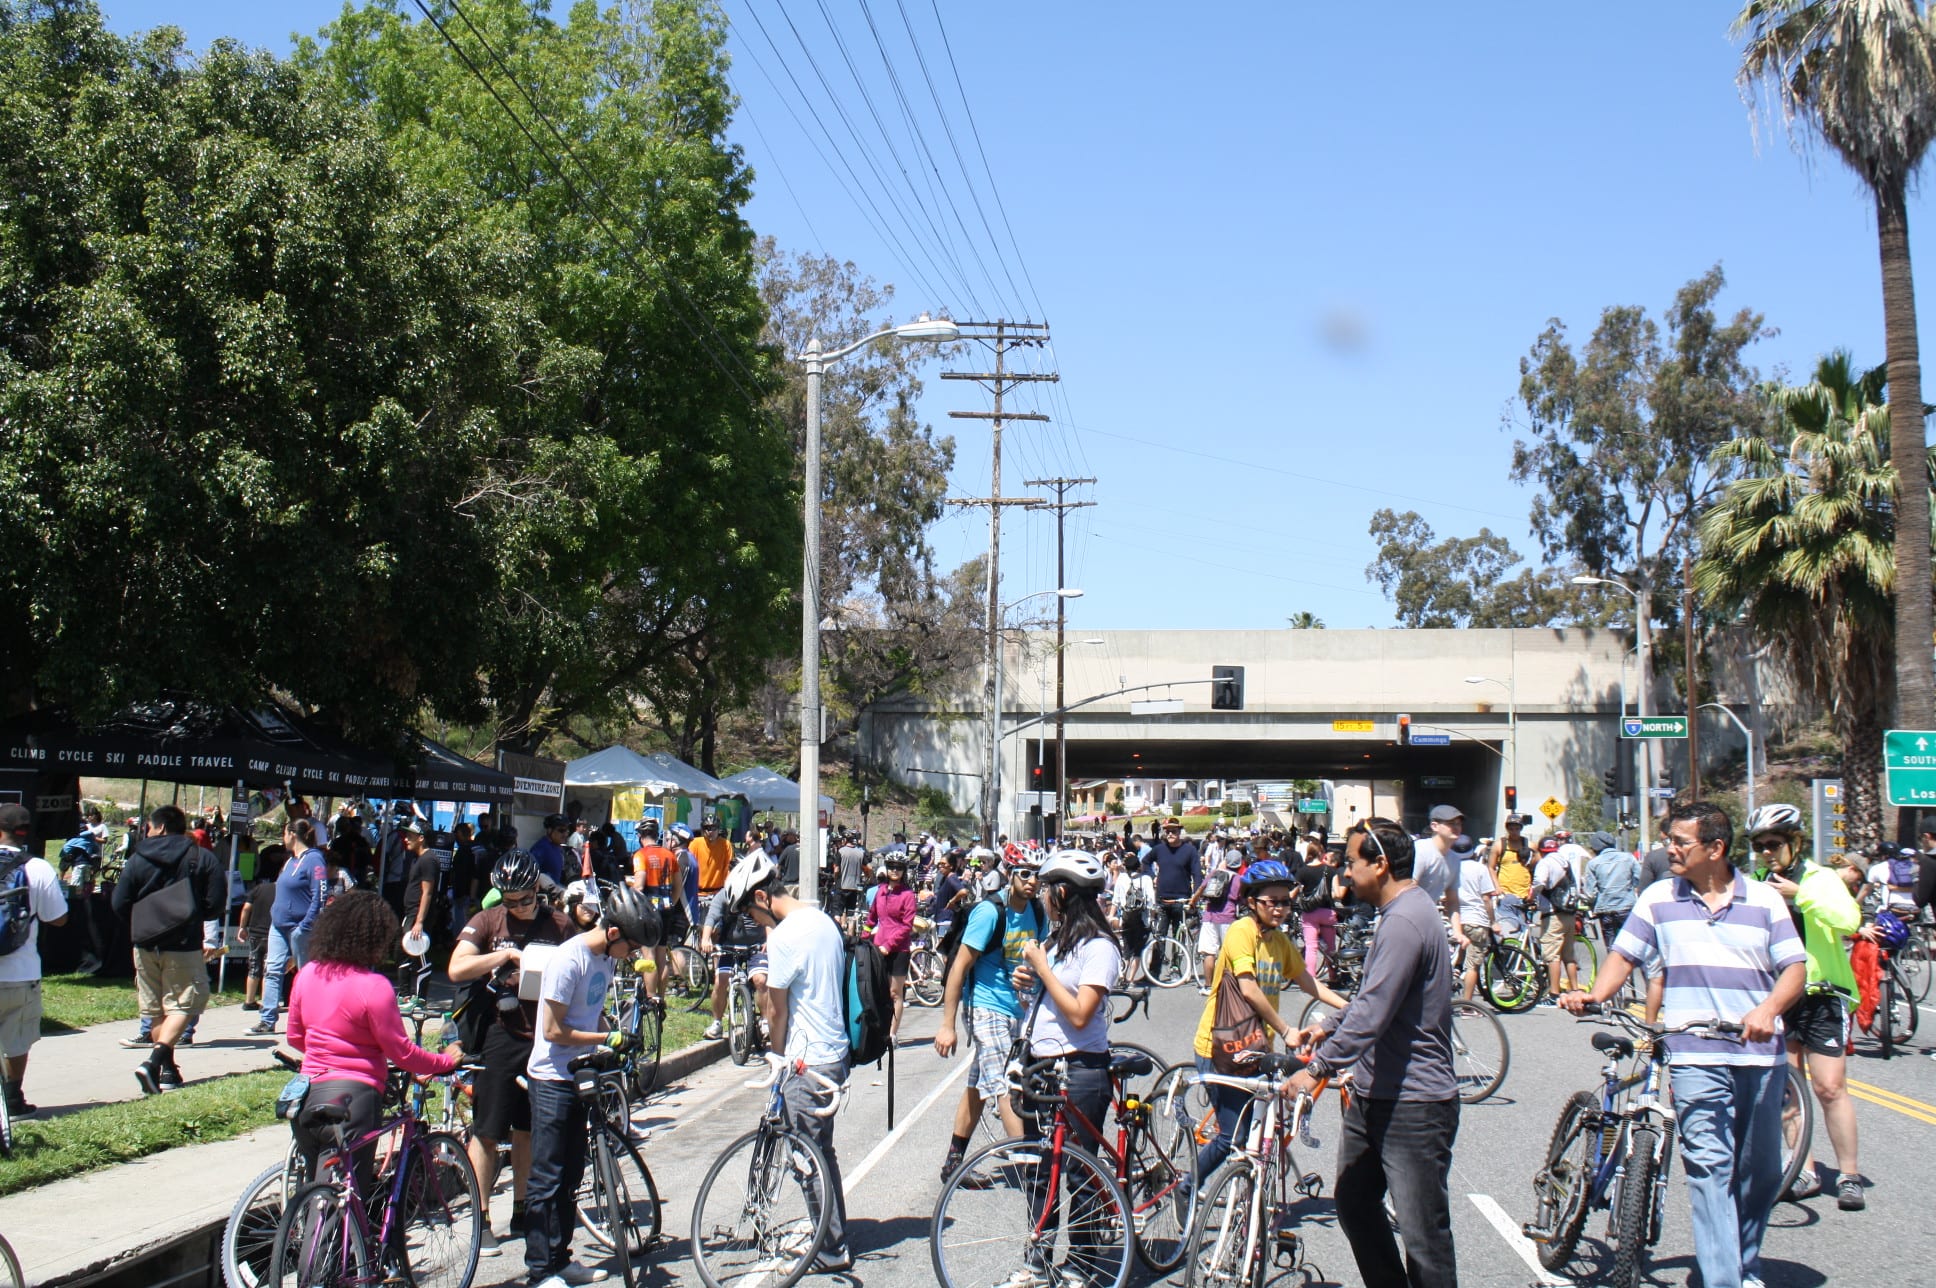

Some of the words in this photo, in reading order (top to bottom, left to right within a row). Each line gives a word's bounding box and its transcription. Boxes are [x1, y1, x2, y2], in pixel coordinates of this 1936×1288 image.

[1642, 723, 1673, 732] NORTH
[11, 747, 46, 760] CLIMB
[59, 750, 94, 762] CYCLE
[106, 752, 125, 764] SKI
[137, 754, 182, 766] PADDLE
[190, 756, 234, 768] TRAVEL
[248, 759, 270, 772] CAMP
[303, 767, 324, 780] CYCLE
[328, 771, 340, 782] SKI
[415, 779, 430, 789] CAMP
